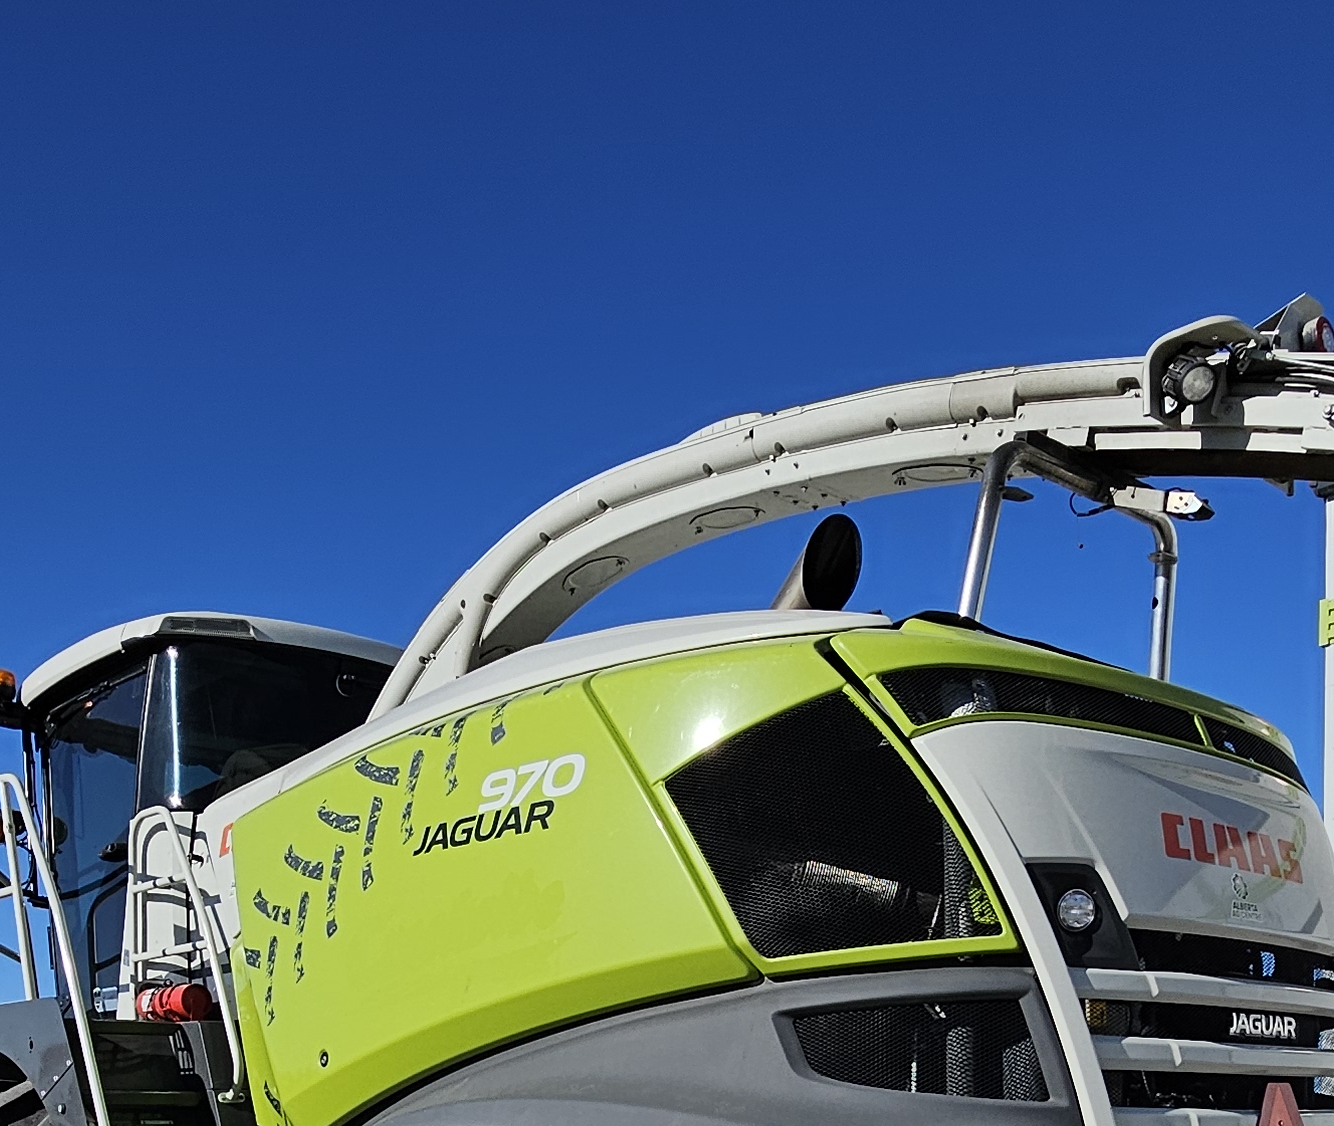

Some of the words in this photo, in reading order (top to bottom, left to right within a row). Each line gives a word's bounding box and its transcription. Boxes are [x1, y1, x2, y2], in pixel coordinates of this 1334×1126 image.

[478, 754, 586, 814] 970
[412, 800, 555, 857] JAGUAR
[1160, 812, 1304, 884] CLAAS
[1229, 1012, 1296, 1039] JAGUAR
